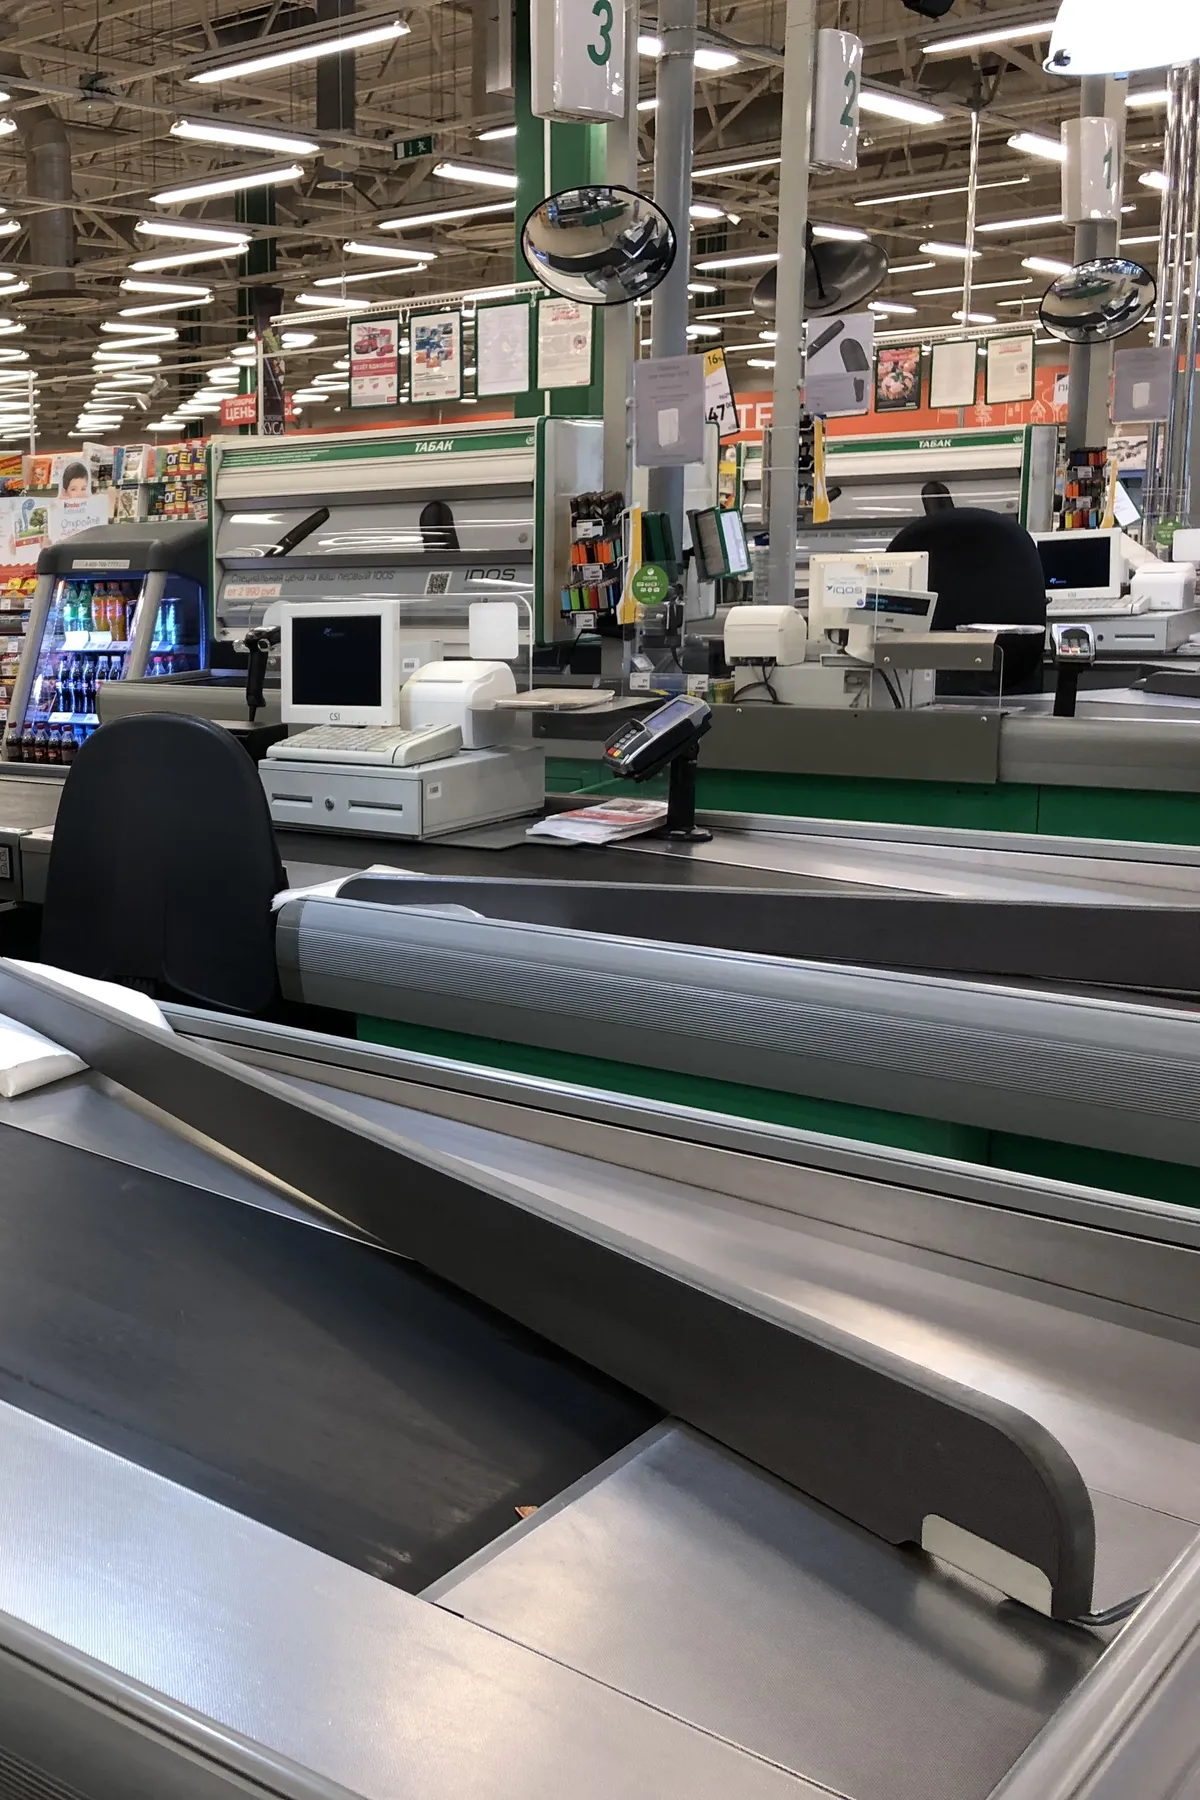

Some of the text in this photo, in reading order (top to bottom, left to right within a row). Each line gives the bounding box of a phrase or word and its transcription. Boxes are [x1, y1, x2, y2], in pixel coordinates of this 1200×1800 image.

[587, 0, 613, 66] 3
[840, 70, 857, 127] 2
[1102, 147, 1113, 189] 1
[414, 439, 454, 453] ТАБАК
[919, 438, 952, 449] ТАБАК
[61, 516, 101, 529] Откройте
[231, 570, 396, 584] Специальная цена на ваш первый IQOS
[227, 587, 277, 598] от 2 990 руб
[330, 712, 341, 721] CSI
